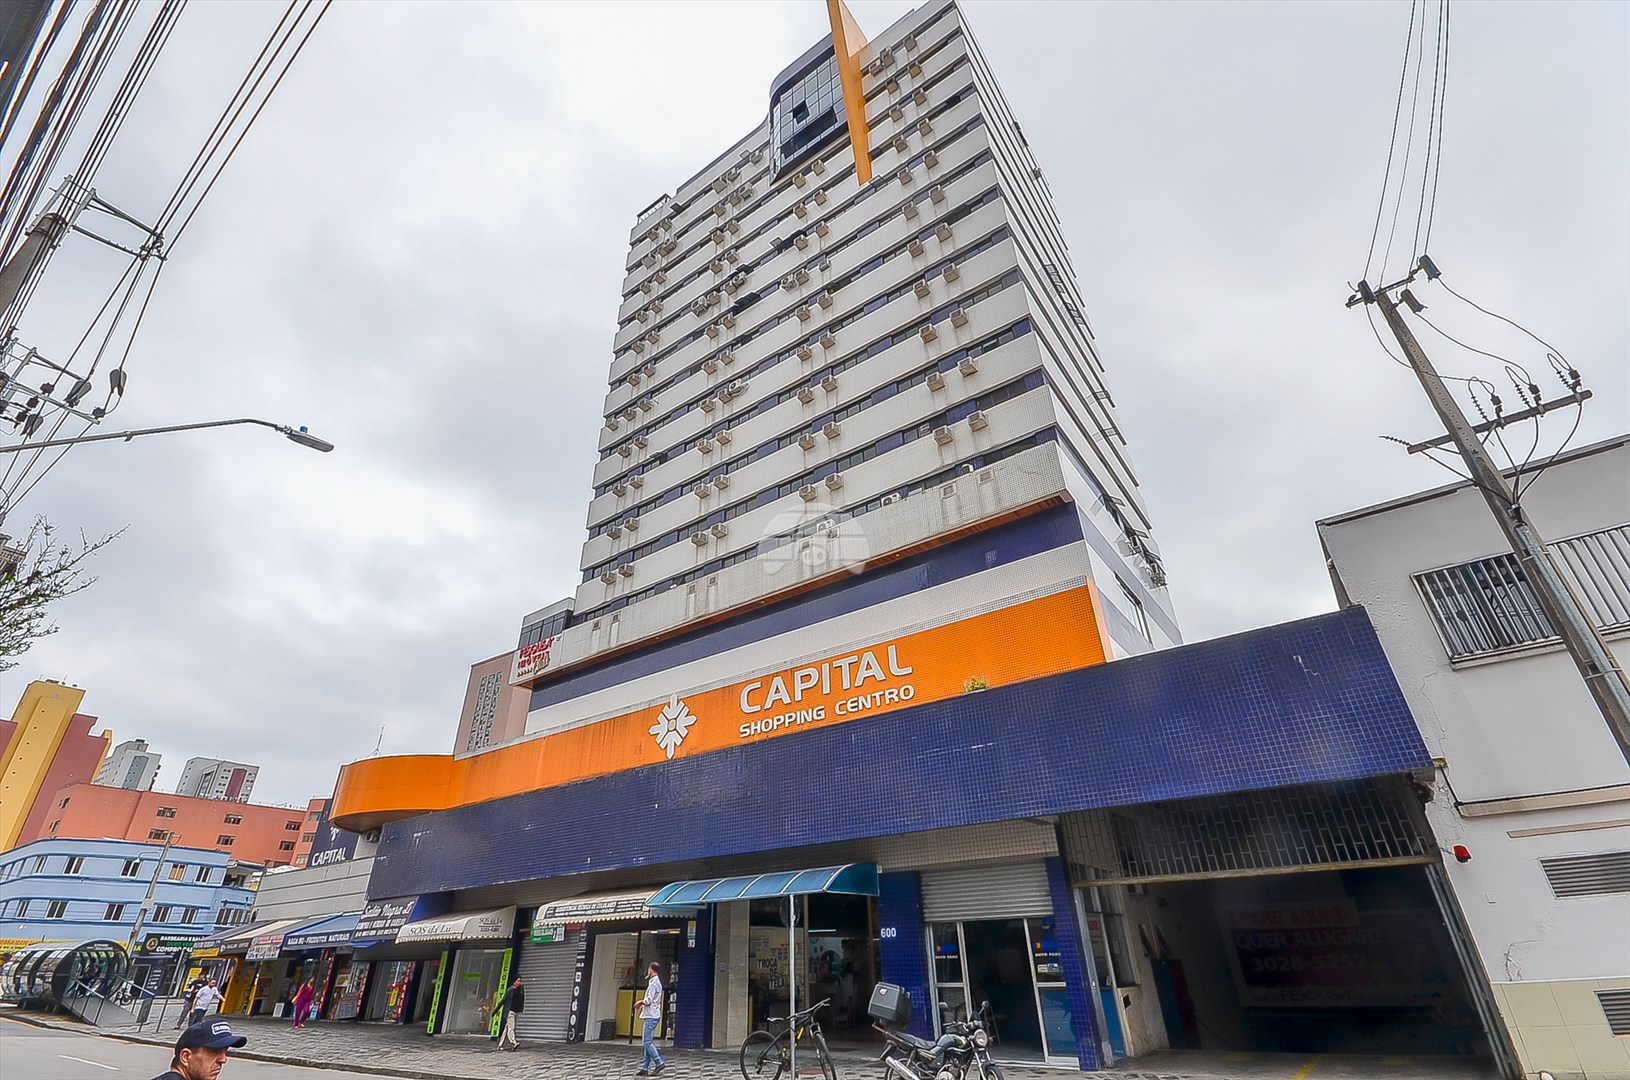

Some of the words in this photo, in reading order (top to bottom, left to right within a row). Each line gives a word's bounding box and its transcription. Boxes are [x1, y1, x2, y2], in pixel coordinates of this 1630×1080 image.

[740, 644, 913, 714] CAPITAL
[739, 705, 826, 738] SHOPPING
[835, 684, 915, 715] CENTRO
[311, 846, 347, 867] CAPITAL
[409, 926, 428, 935] SOS
[880, 927, 897, 938] 600
[1235, 932, 1288, 950] QUER
[757, 958, 778, 970] TROCA
[769, 977, 786, 990] TELA
[493, 965, 508, 1036] COSTRAS
